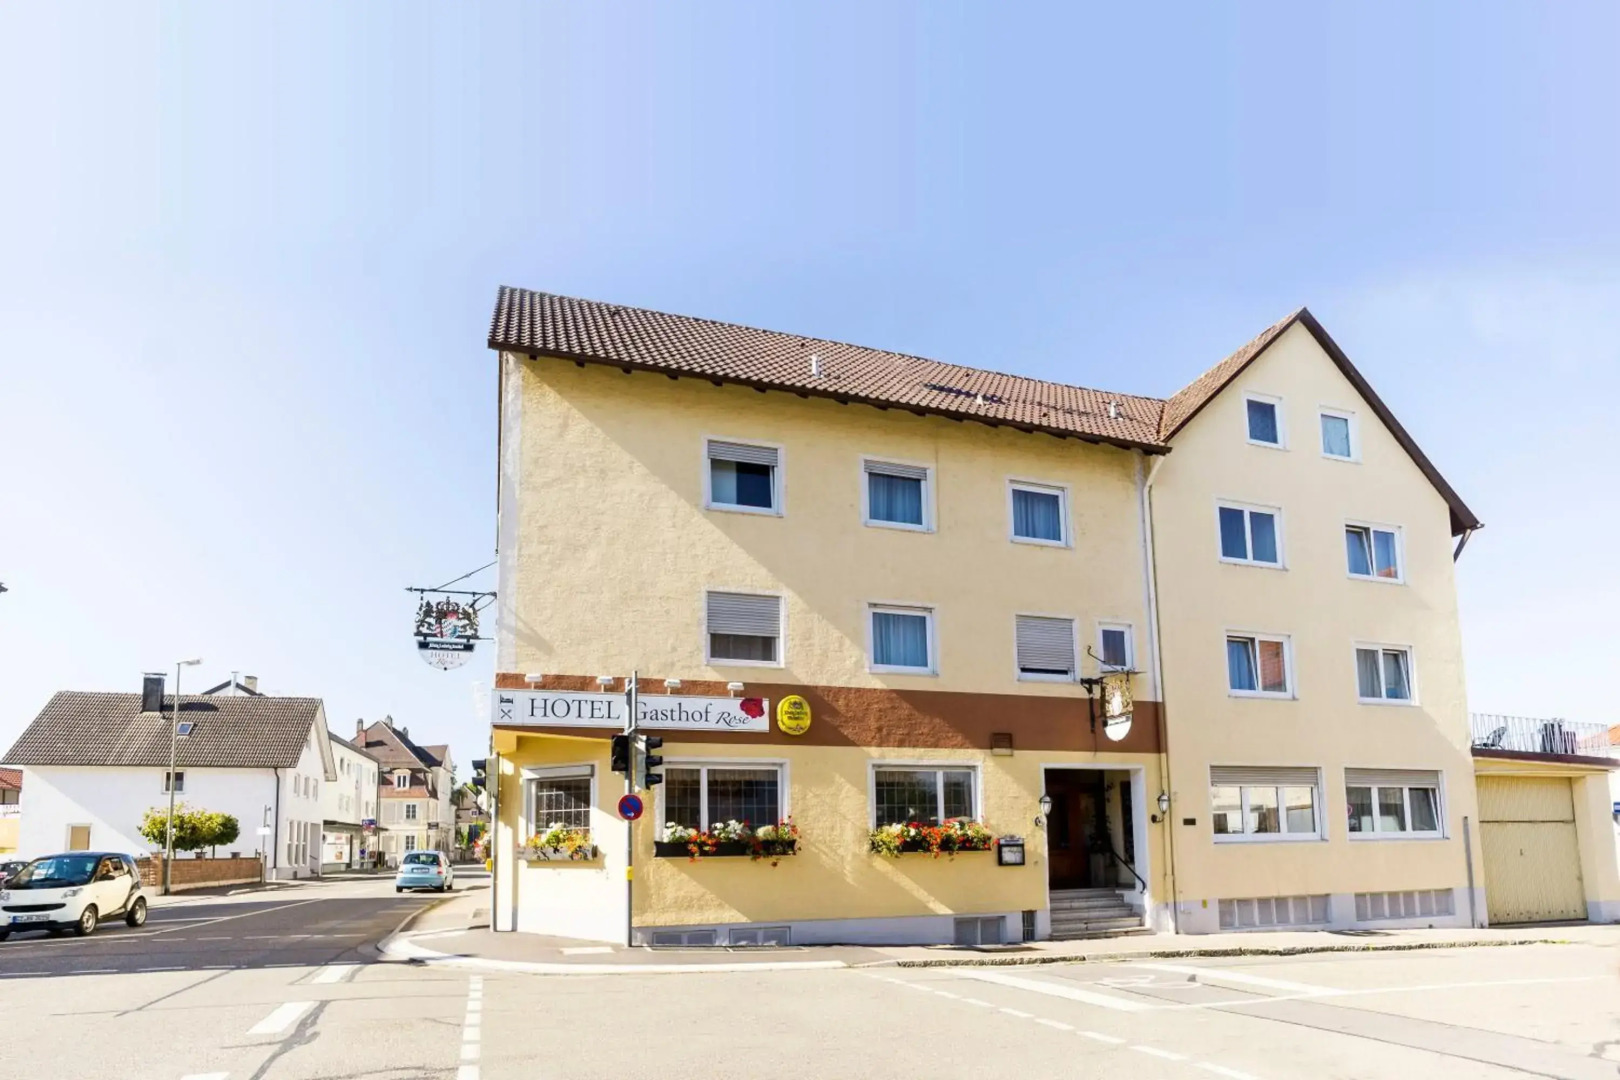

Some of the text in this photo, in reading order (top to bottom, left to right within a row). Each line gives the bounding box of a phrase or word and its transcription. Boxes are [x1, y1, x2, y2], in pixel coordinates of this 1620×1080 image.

[528, 698, 751, 728] HOTEL Gasthof Rose
